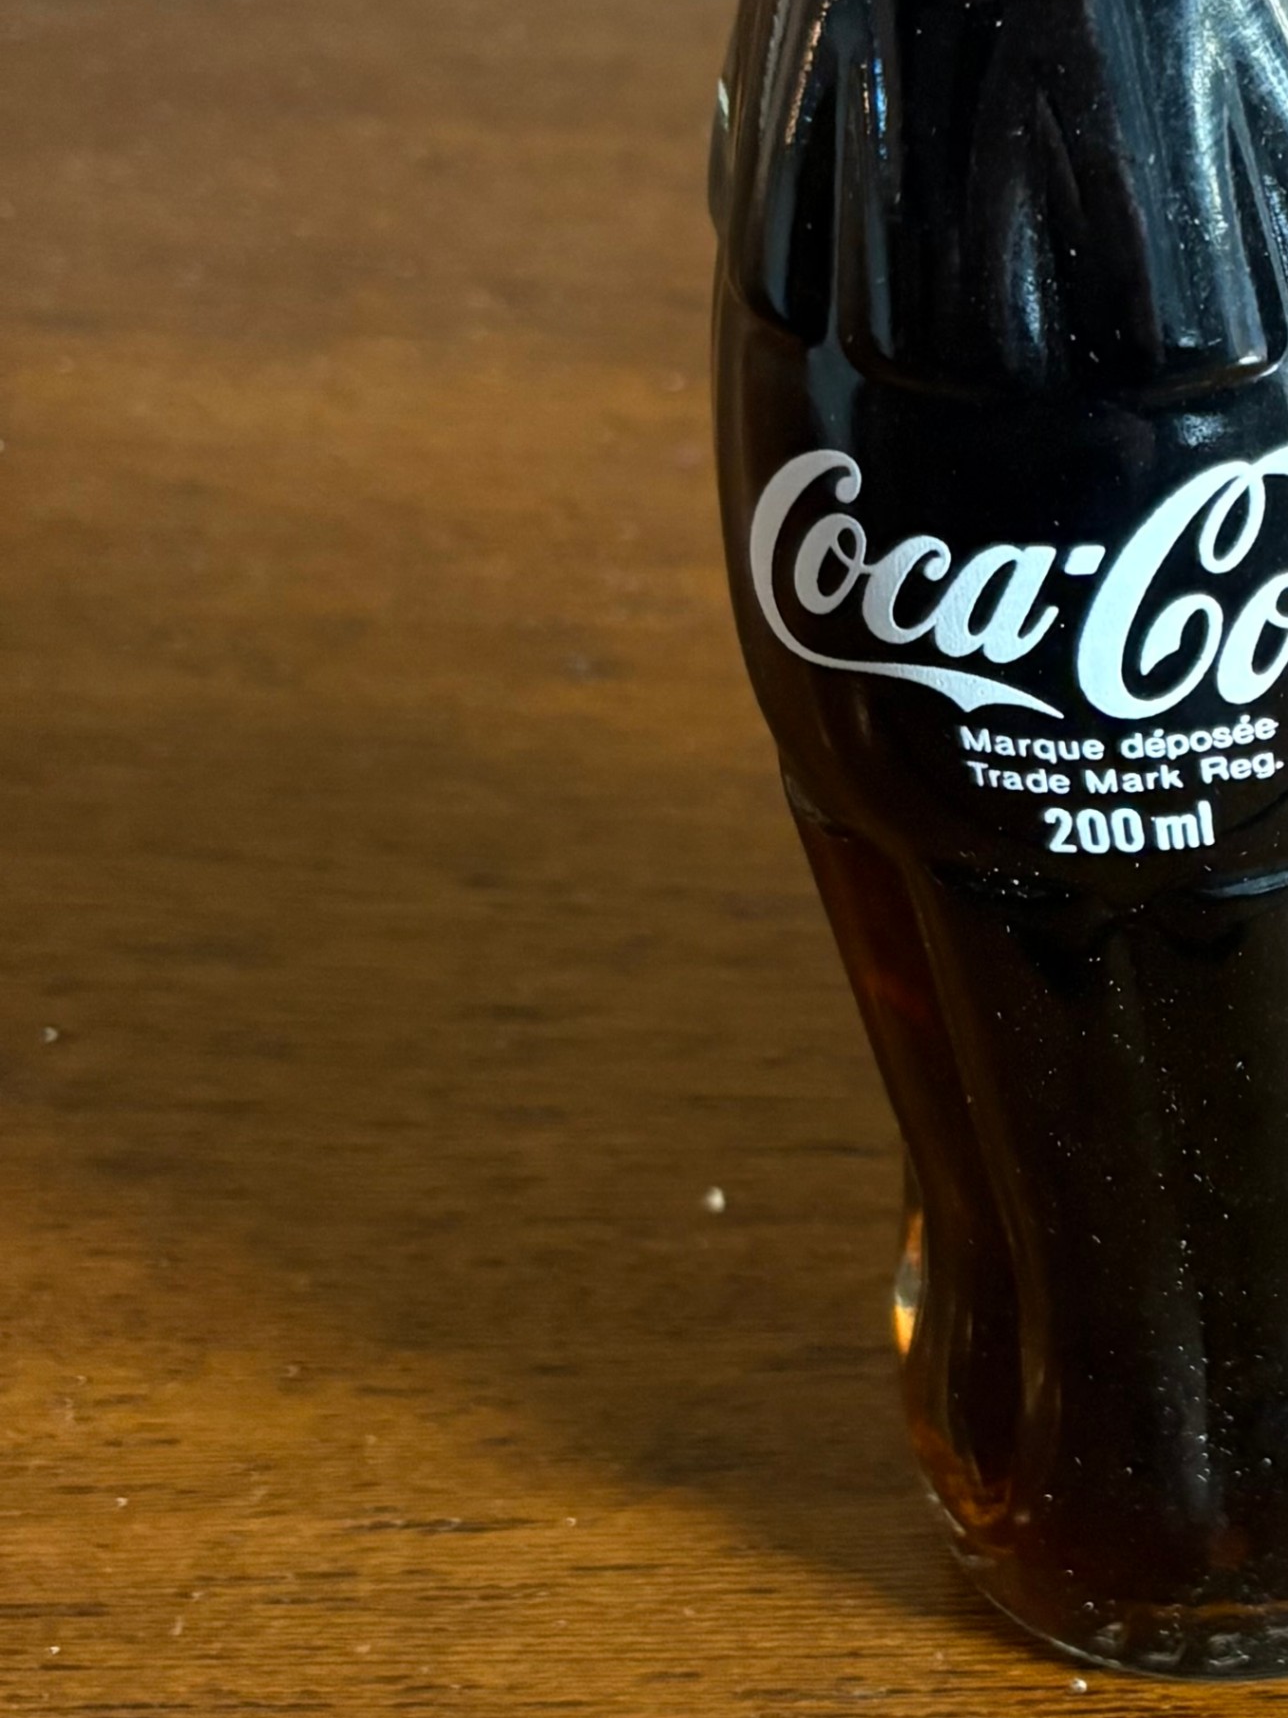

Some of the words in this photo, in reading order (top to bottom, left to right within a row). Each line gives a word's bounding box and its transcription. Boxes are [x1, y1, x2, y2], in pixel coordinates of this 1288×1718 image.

[959, 724, 1106, 764] Marque
[1120, 715, 1279, 759] déposée
[966, 760, 1071, 795] Trade
[1086, 764, 1184, 794] Mark
[1201, 752, 1286, 785] Reg.
[1043, 807, 1146, 854] 200
[1155, 800, 1216, 850] ml
